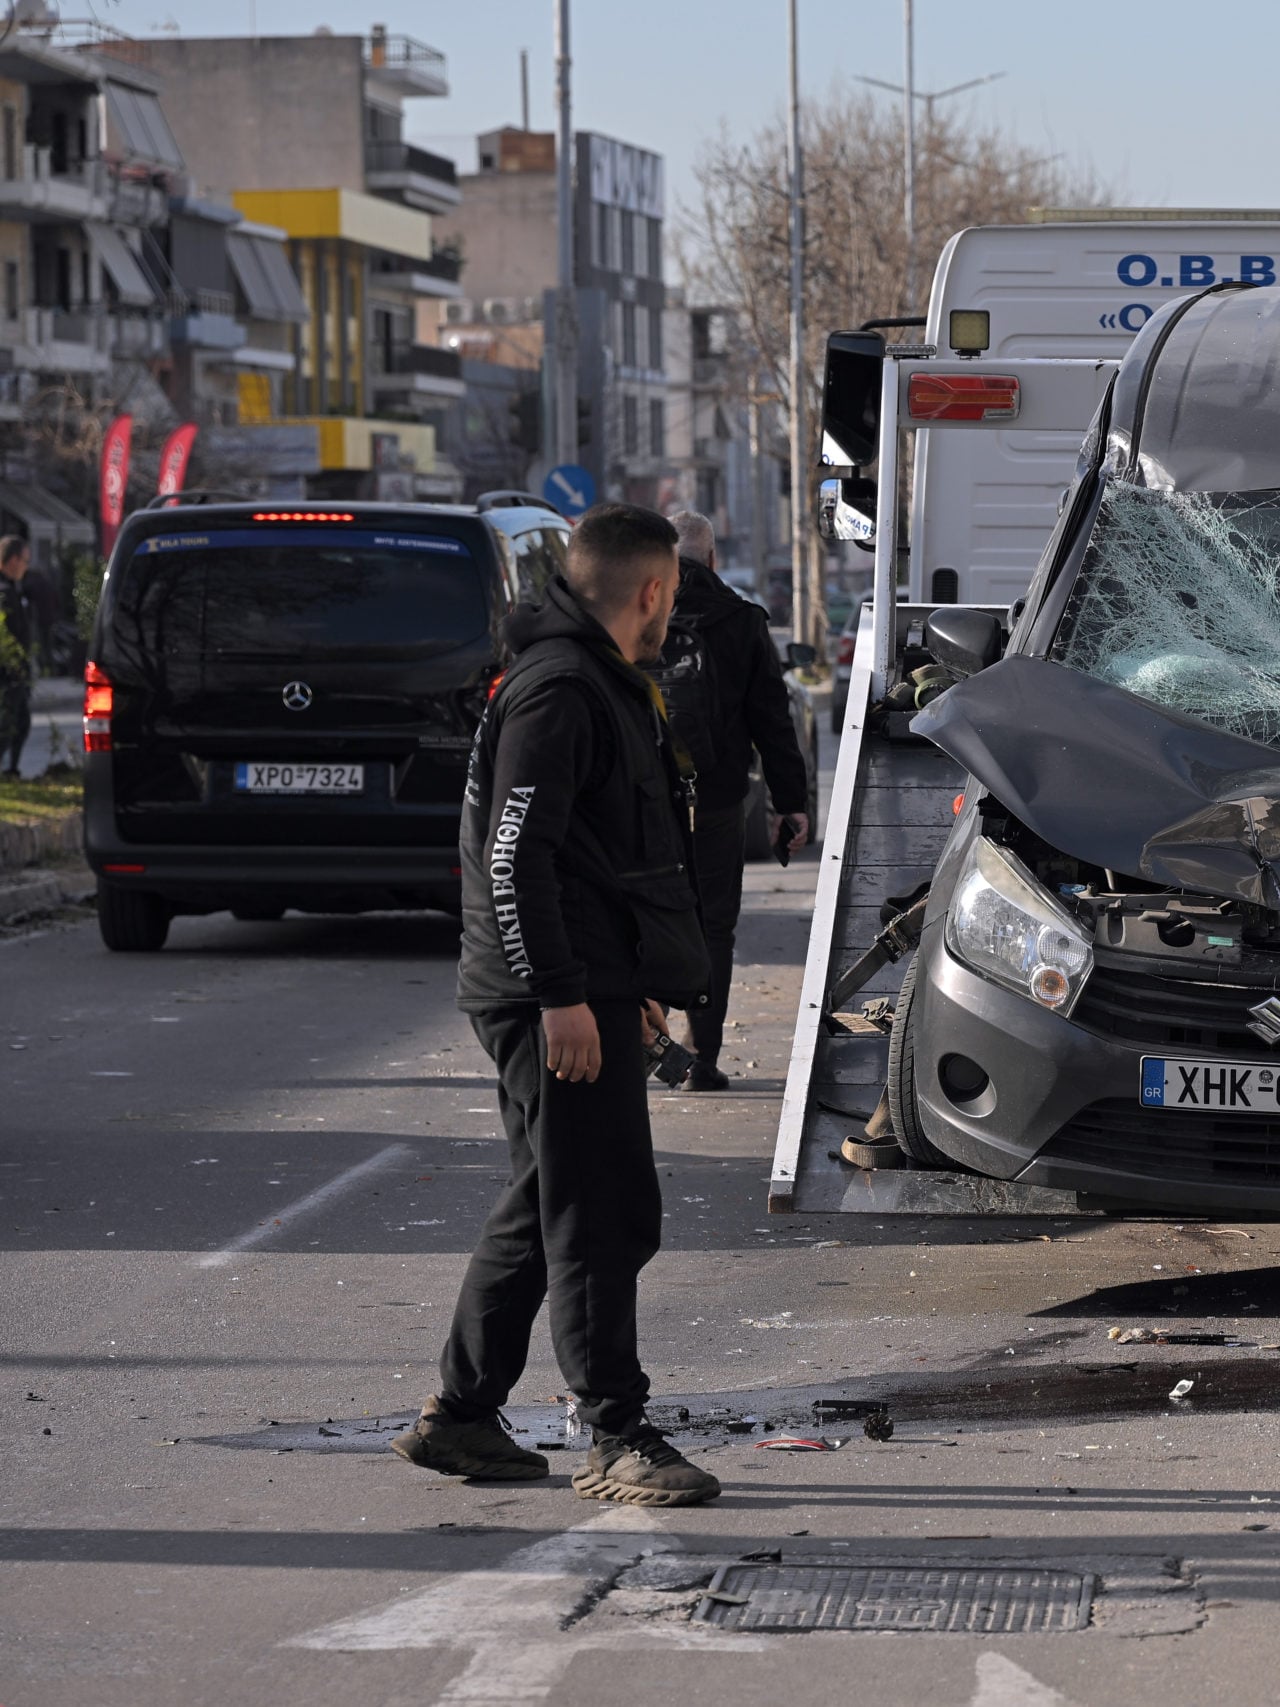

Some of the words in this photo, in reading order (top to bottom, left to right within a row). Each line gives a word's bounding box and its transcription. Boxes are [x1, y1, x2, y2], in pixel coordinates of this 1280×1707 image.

[253, 767, 359, 787] XPO-7324
[490, 785, 536, 897] ΒΟΗΘΕΙΑ
[1144, 1087, 1162, 1098] GR
